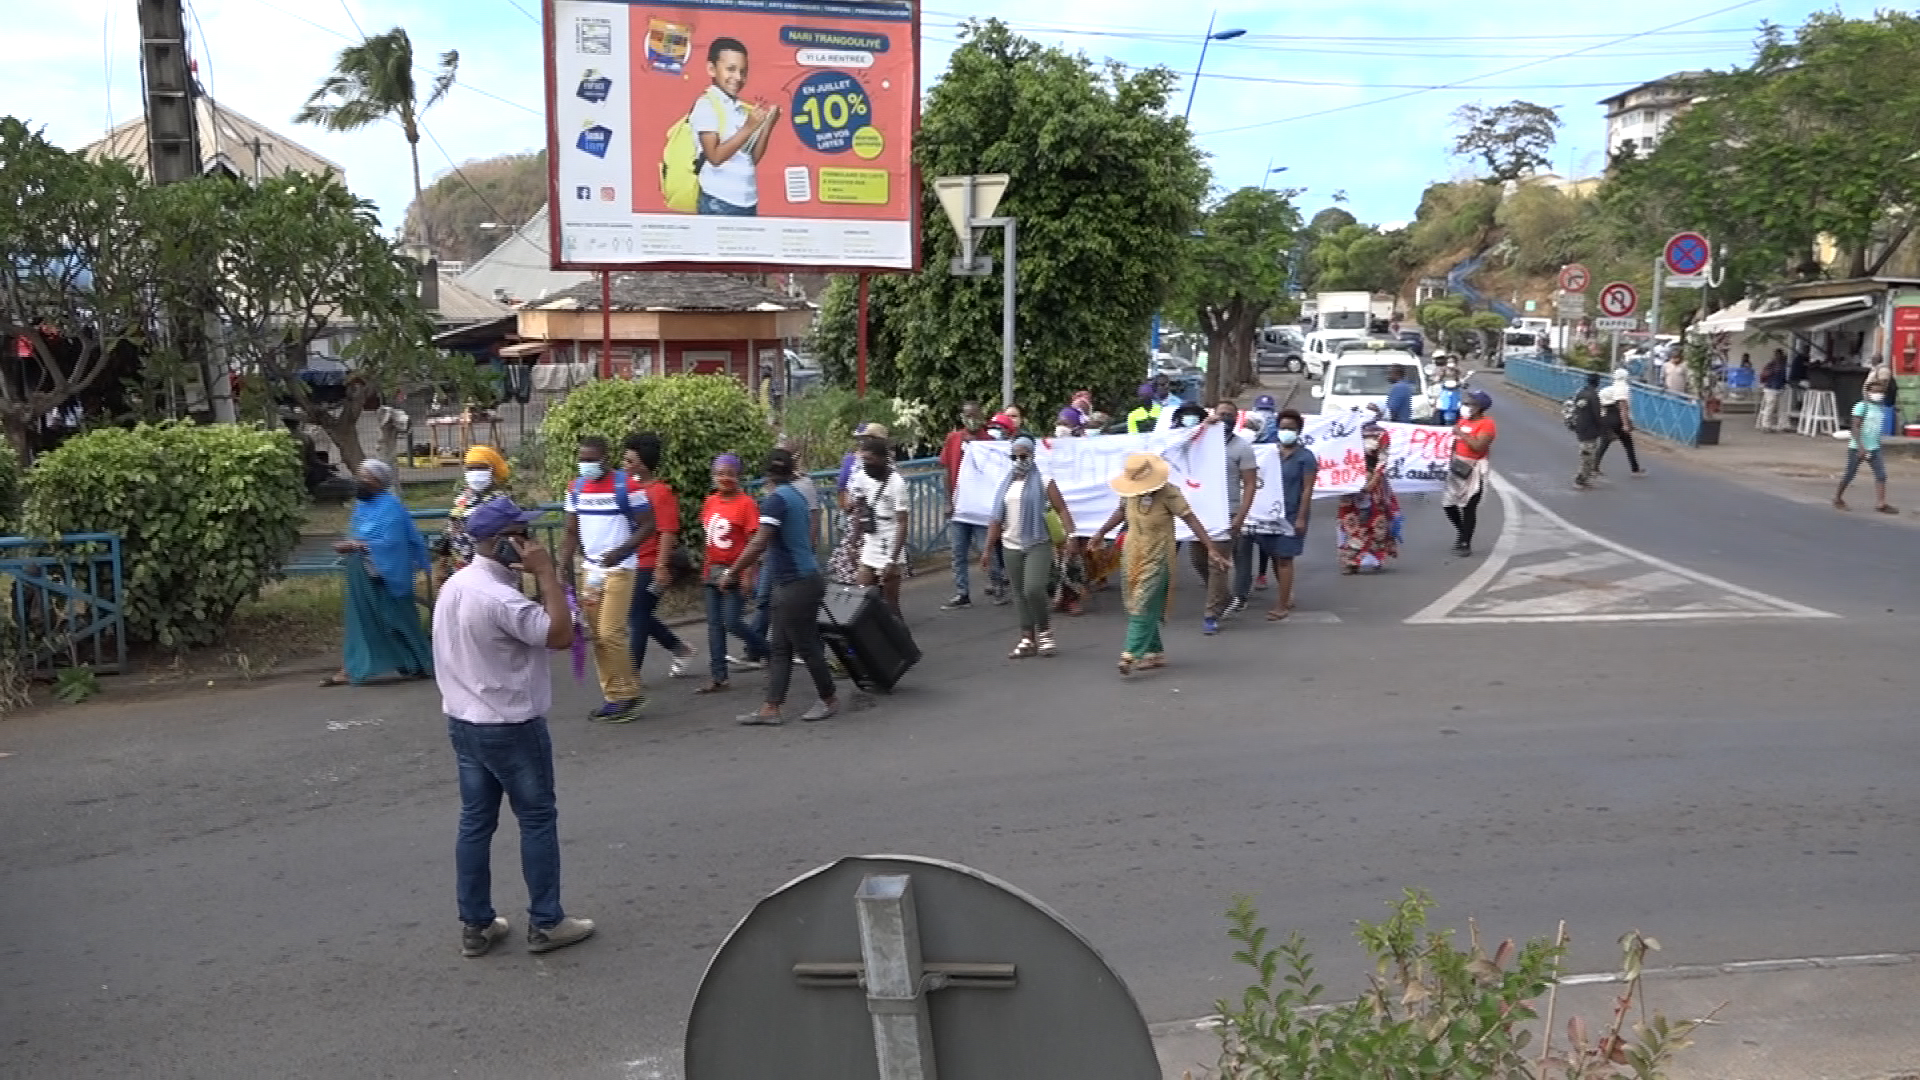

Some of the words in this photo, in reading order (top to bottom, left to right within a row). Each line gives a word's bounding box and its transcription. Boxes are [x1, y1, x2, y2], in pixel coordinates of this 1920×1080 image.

[788, 31, 813, 41] NARI
[803, 86, 816, 95] EN
[816, 80, 850, 93] JUILLET
[794, 93, 867, 130] -10%
[816, 133, 832, 141] SUR
[832, 129, 850, 138] VOS
[818, 139, 844, 149] LISTES
